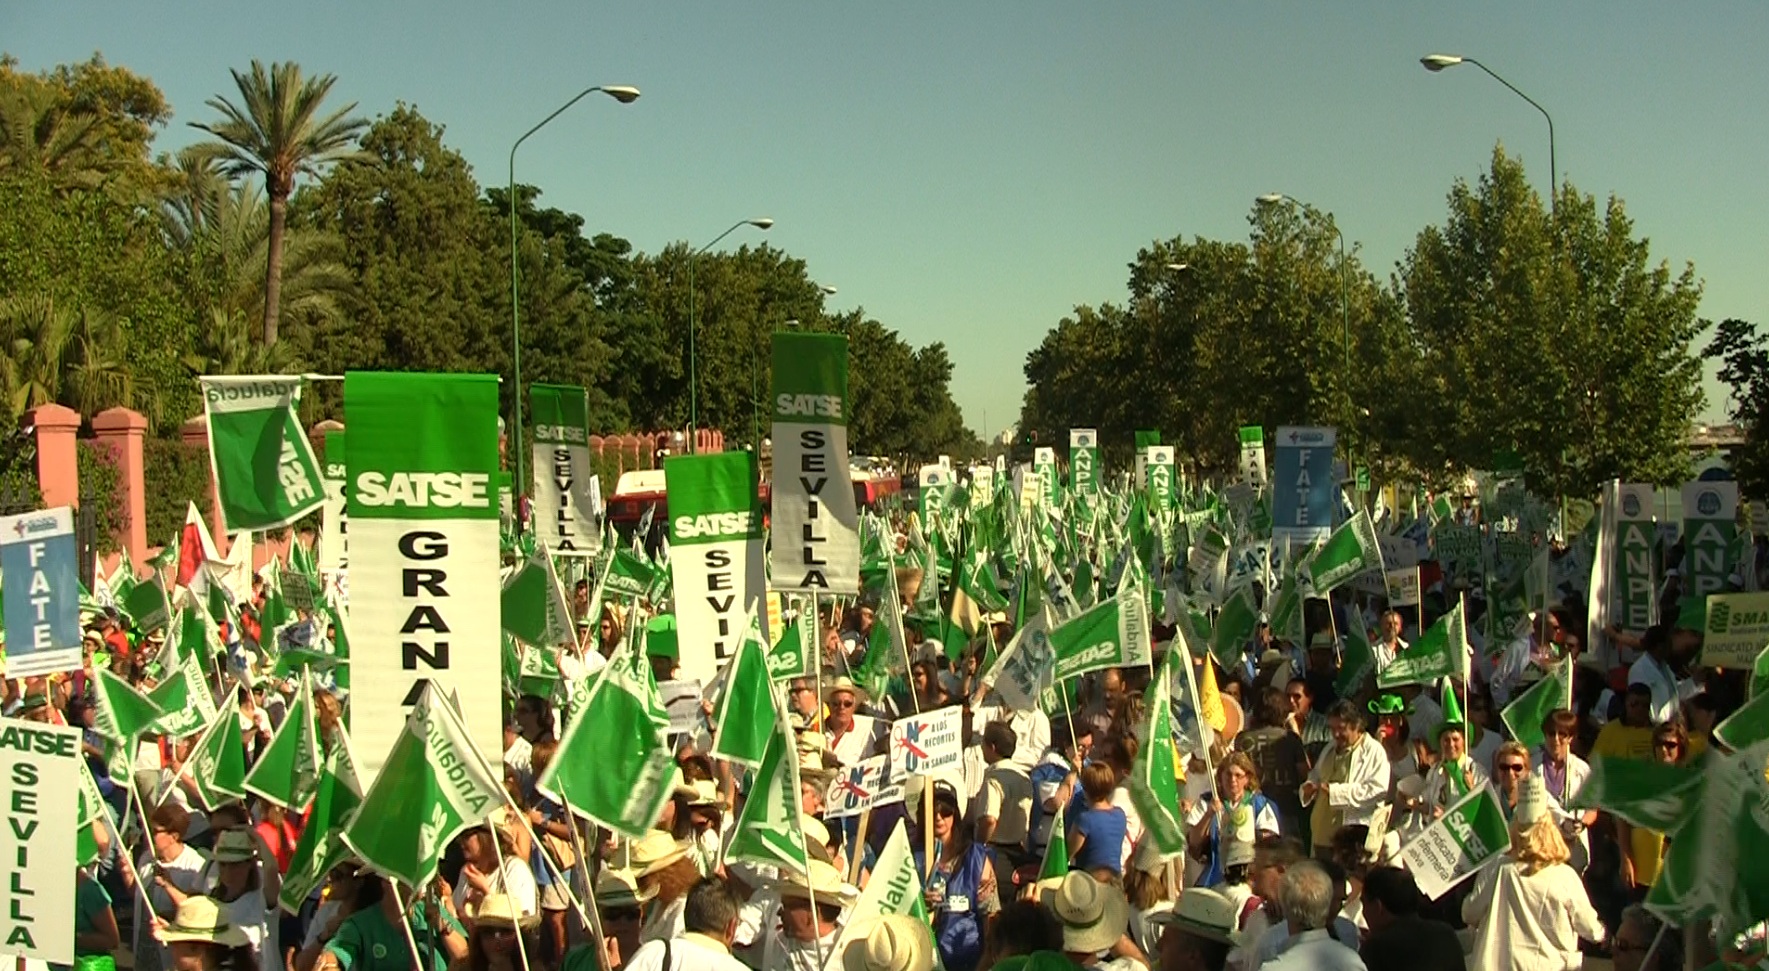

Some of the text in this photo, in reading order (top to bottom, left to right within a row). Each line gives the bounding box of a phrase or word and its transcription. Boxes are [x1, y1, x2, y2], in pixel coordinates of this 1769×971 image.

[776, 393, 842, 418] SATSE
[536, 425, 585, 442] SATSE
[355, 472, 490, 508] SATSE
[1073, 449, 1092, 494] ANPE
[1296, 449, 1312, 525] FATE
[553, 450, 578, 551] SEVILLA
[800, 431, 829, 589] SEVILLA
[675, 511, 755, 539] SATSE
[29, 542, 52, 650] FATE
[1624, 526, 1649, 627] ANPE
[0, 726, 77, 758] ATSE
[924, 732, 956, 749] RECORTES
[931, 752, 957, 769] SANIDAD
[6, 762, 40, 949] SEVILLA
[1448, 811, 1490, 862] SATSE
